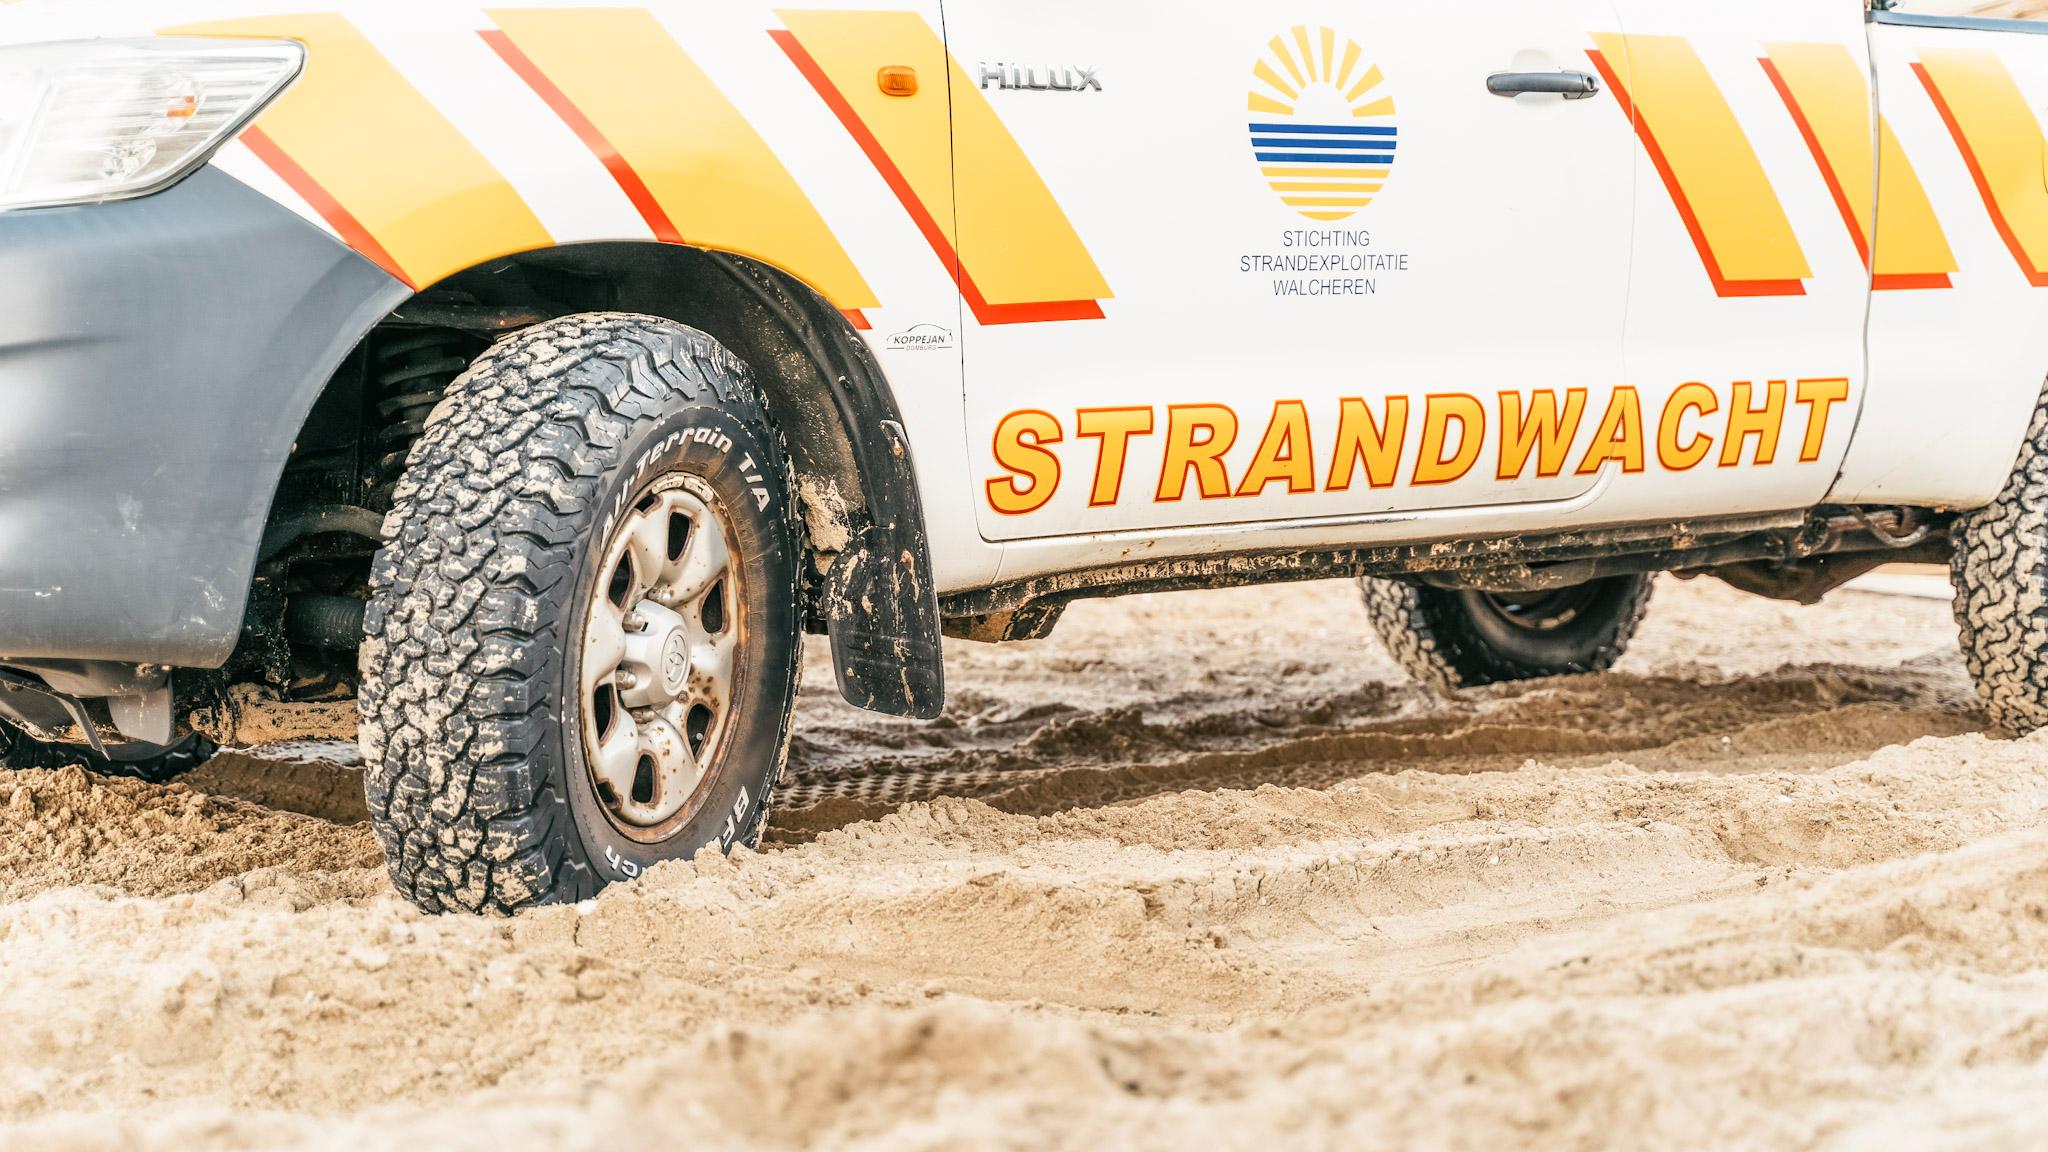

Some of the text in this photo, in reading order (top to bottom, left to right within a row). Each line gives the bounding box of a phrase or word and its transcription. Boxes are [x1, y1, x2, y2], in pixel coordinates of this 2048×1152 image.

[1283, 230, 1370, 247] STICHTING
[1240, 254, 1409, 273] STRANDEXPLOITATIE
[1273, 278, 1376, 296] WALCHEREN
[893, 335, 945, 345] KOPPEJAN
[985, 377, 1849, 516] STRANDWACHT
